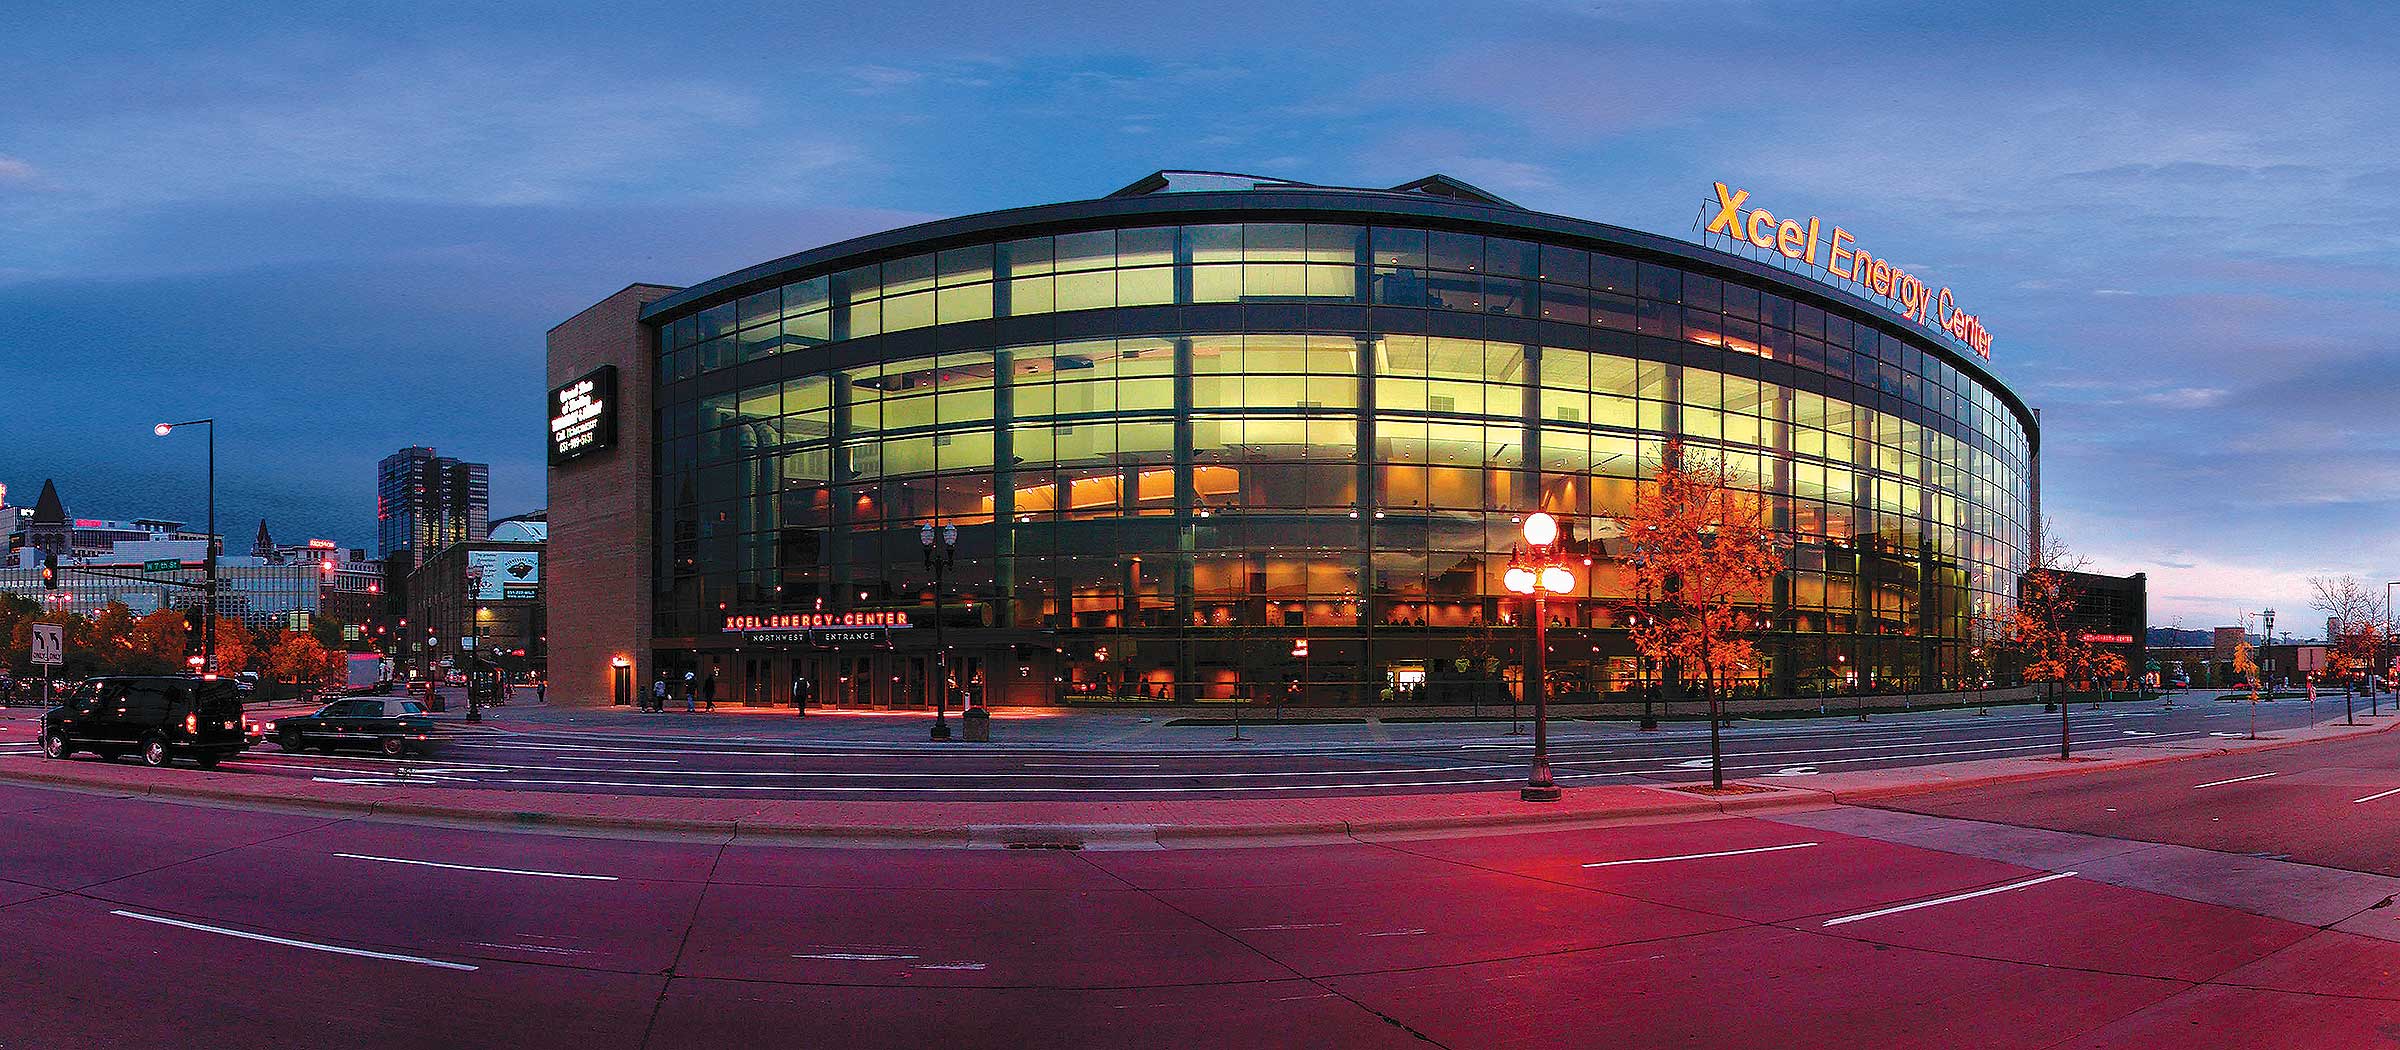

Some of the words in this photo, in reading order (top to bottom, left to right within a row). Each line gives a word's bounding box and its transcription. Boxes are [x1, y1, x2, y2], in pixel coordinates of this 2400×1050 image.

[1705, 181, 1820, 265] Xcel
[1828, 225, 1933, 326] Energy
[1937, 287, 1994, 361] Center
[844, 611, 907, 626] CENTER
[752, 633, 804, 642] NORTHWEST
[825, 632, 876, 641] ENTRANCE
